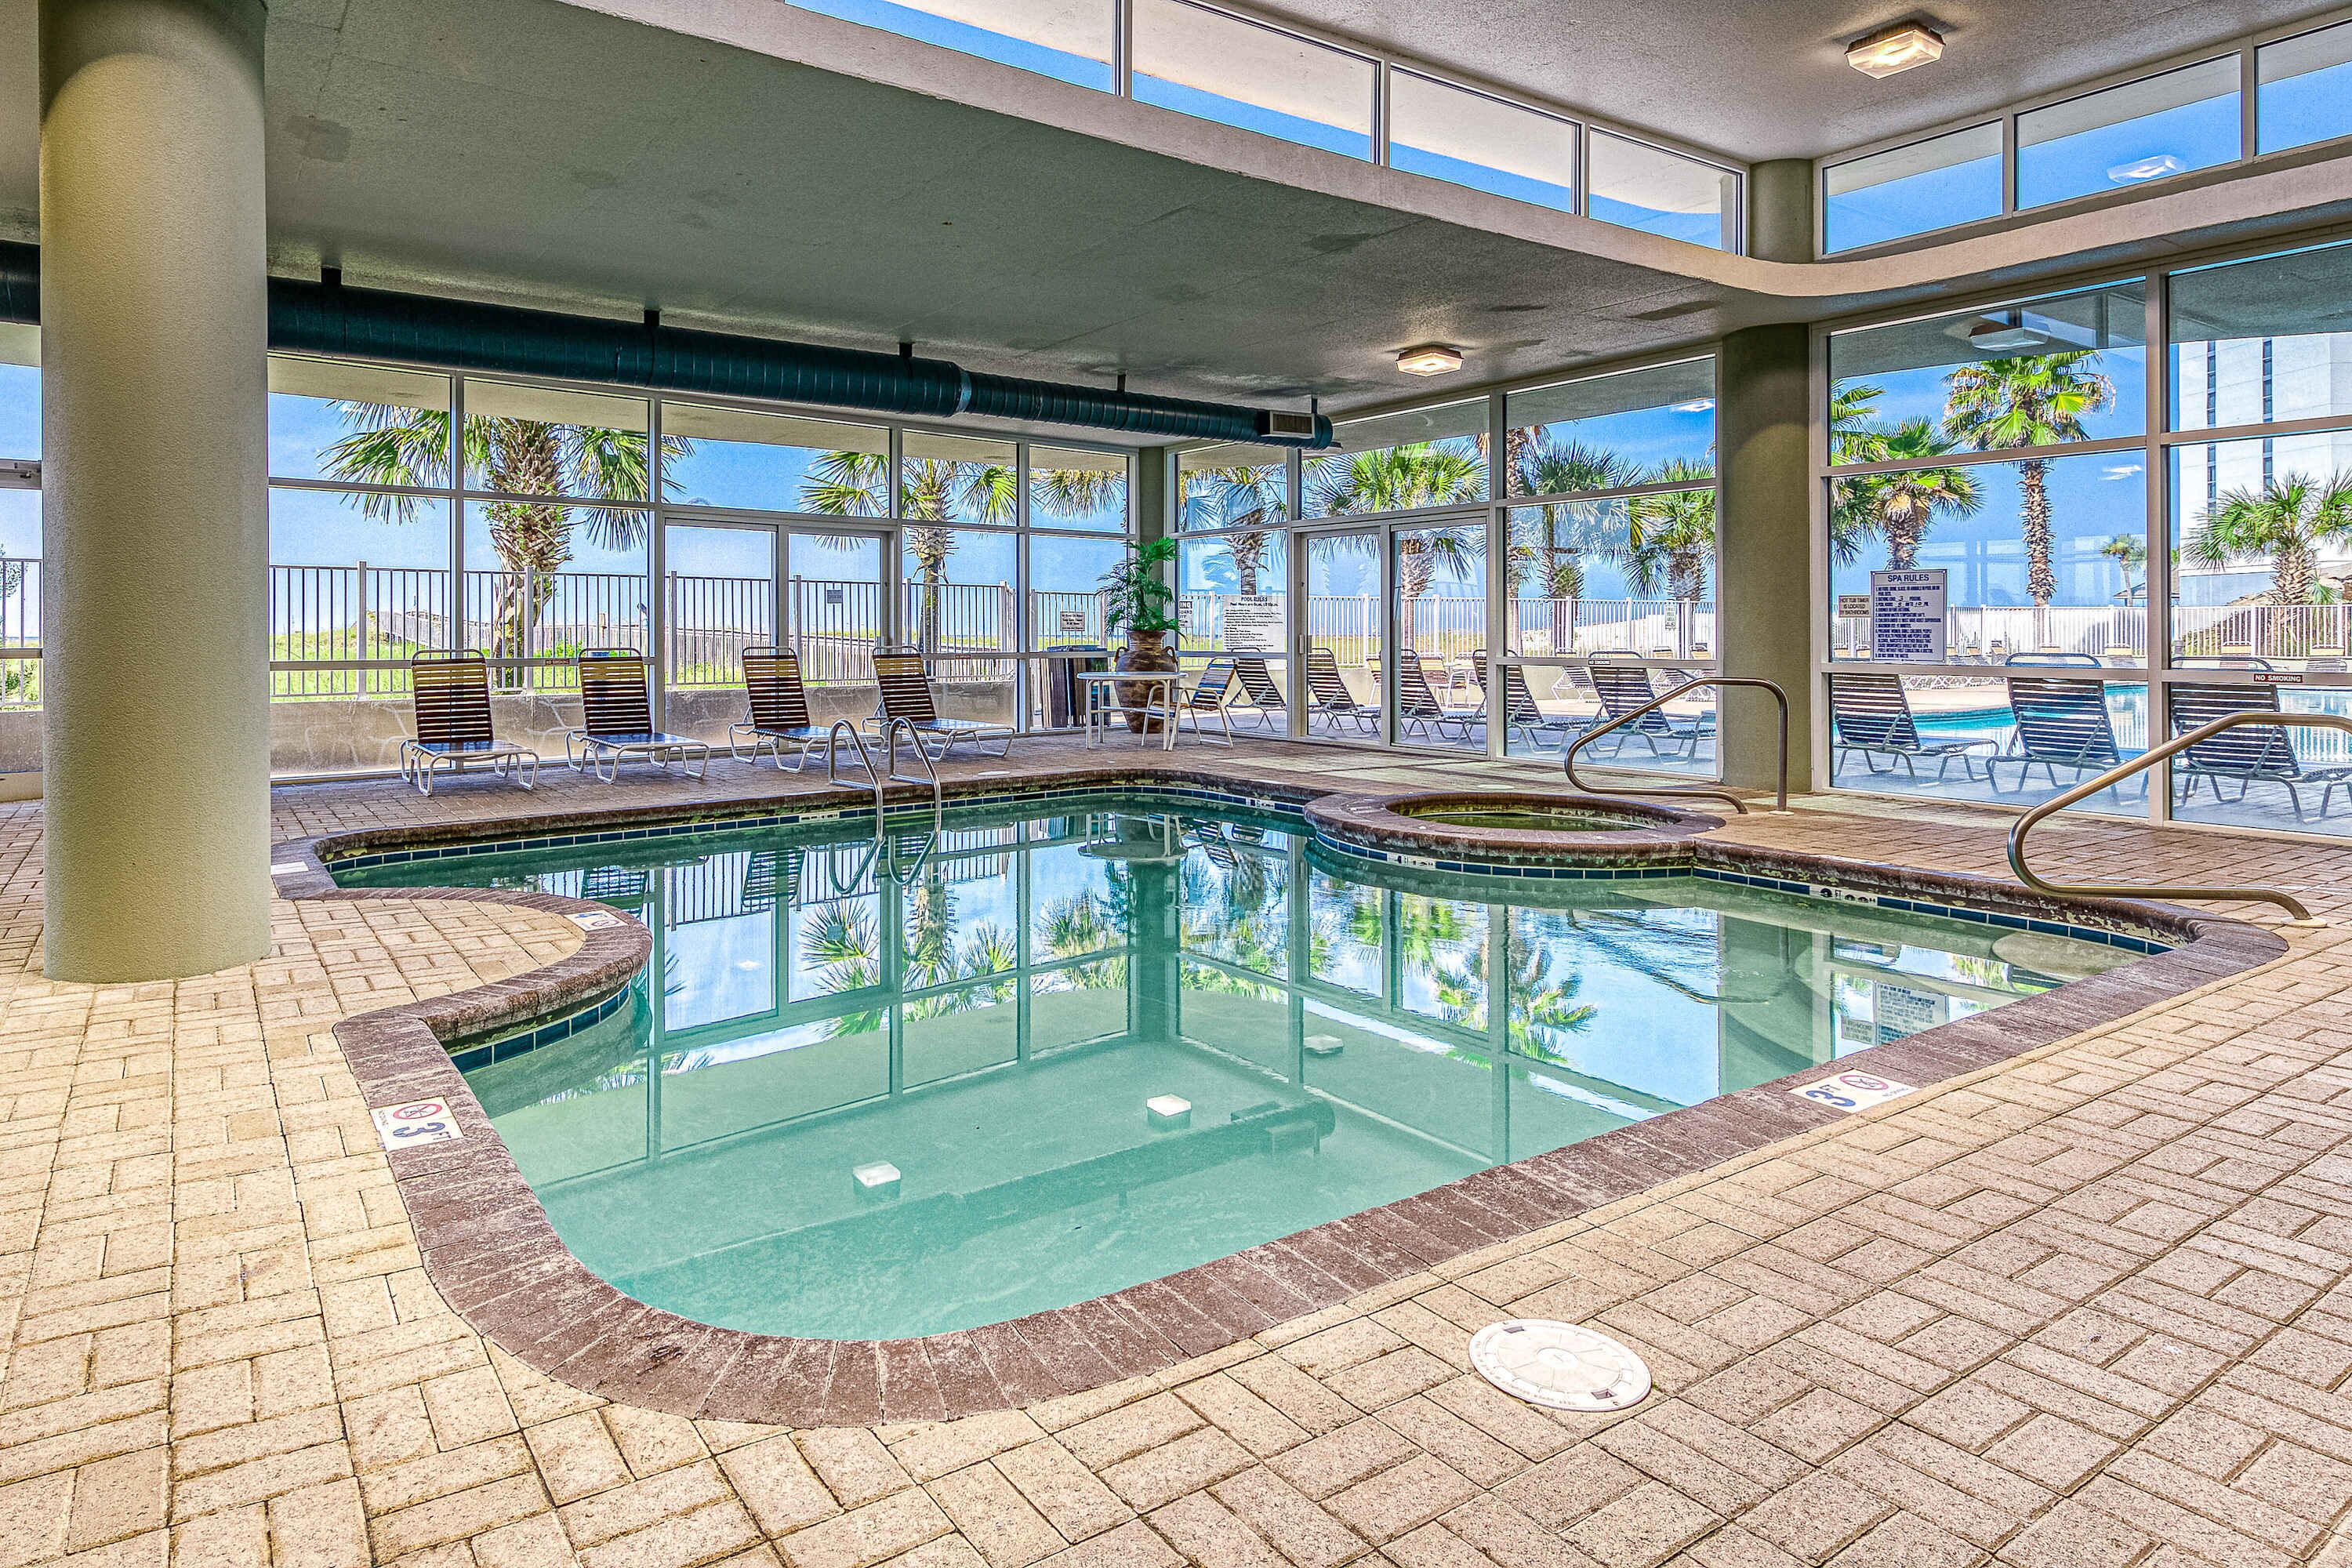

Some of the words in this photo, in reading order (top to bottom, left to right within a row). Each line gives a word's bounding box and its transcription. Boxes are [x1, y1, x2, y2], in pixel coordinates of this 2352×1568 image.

[1819, 1084, 1841, 1093] FT
[1806, 1091, 1856, 1107] 3
[393, 1123, 445, 1137] 3
[430, 1131, 452, 1141] FT
